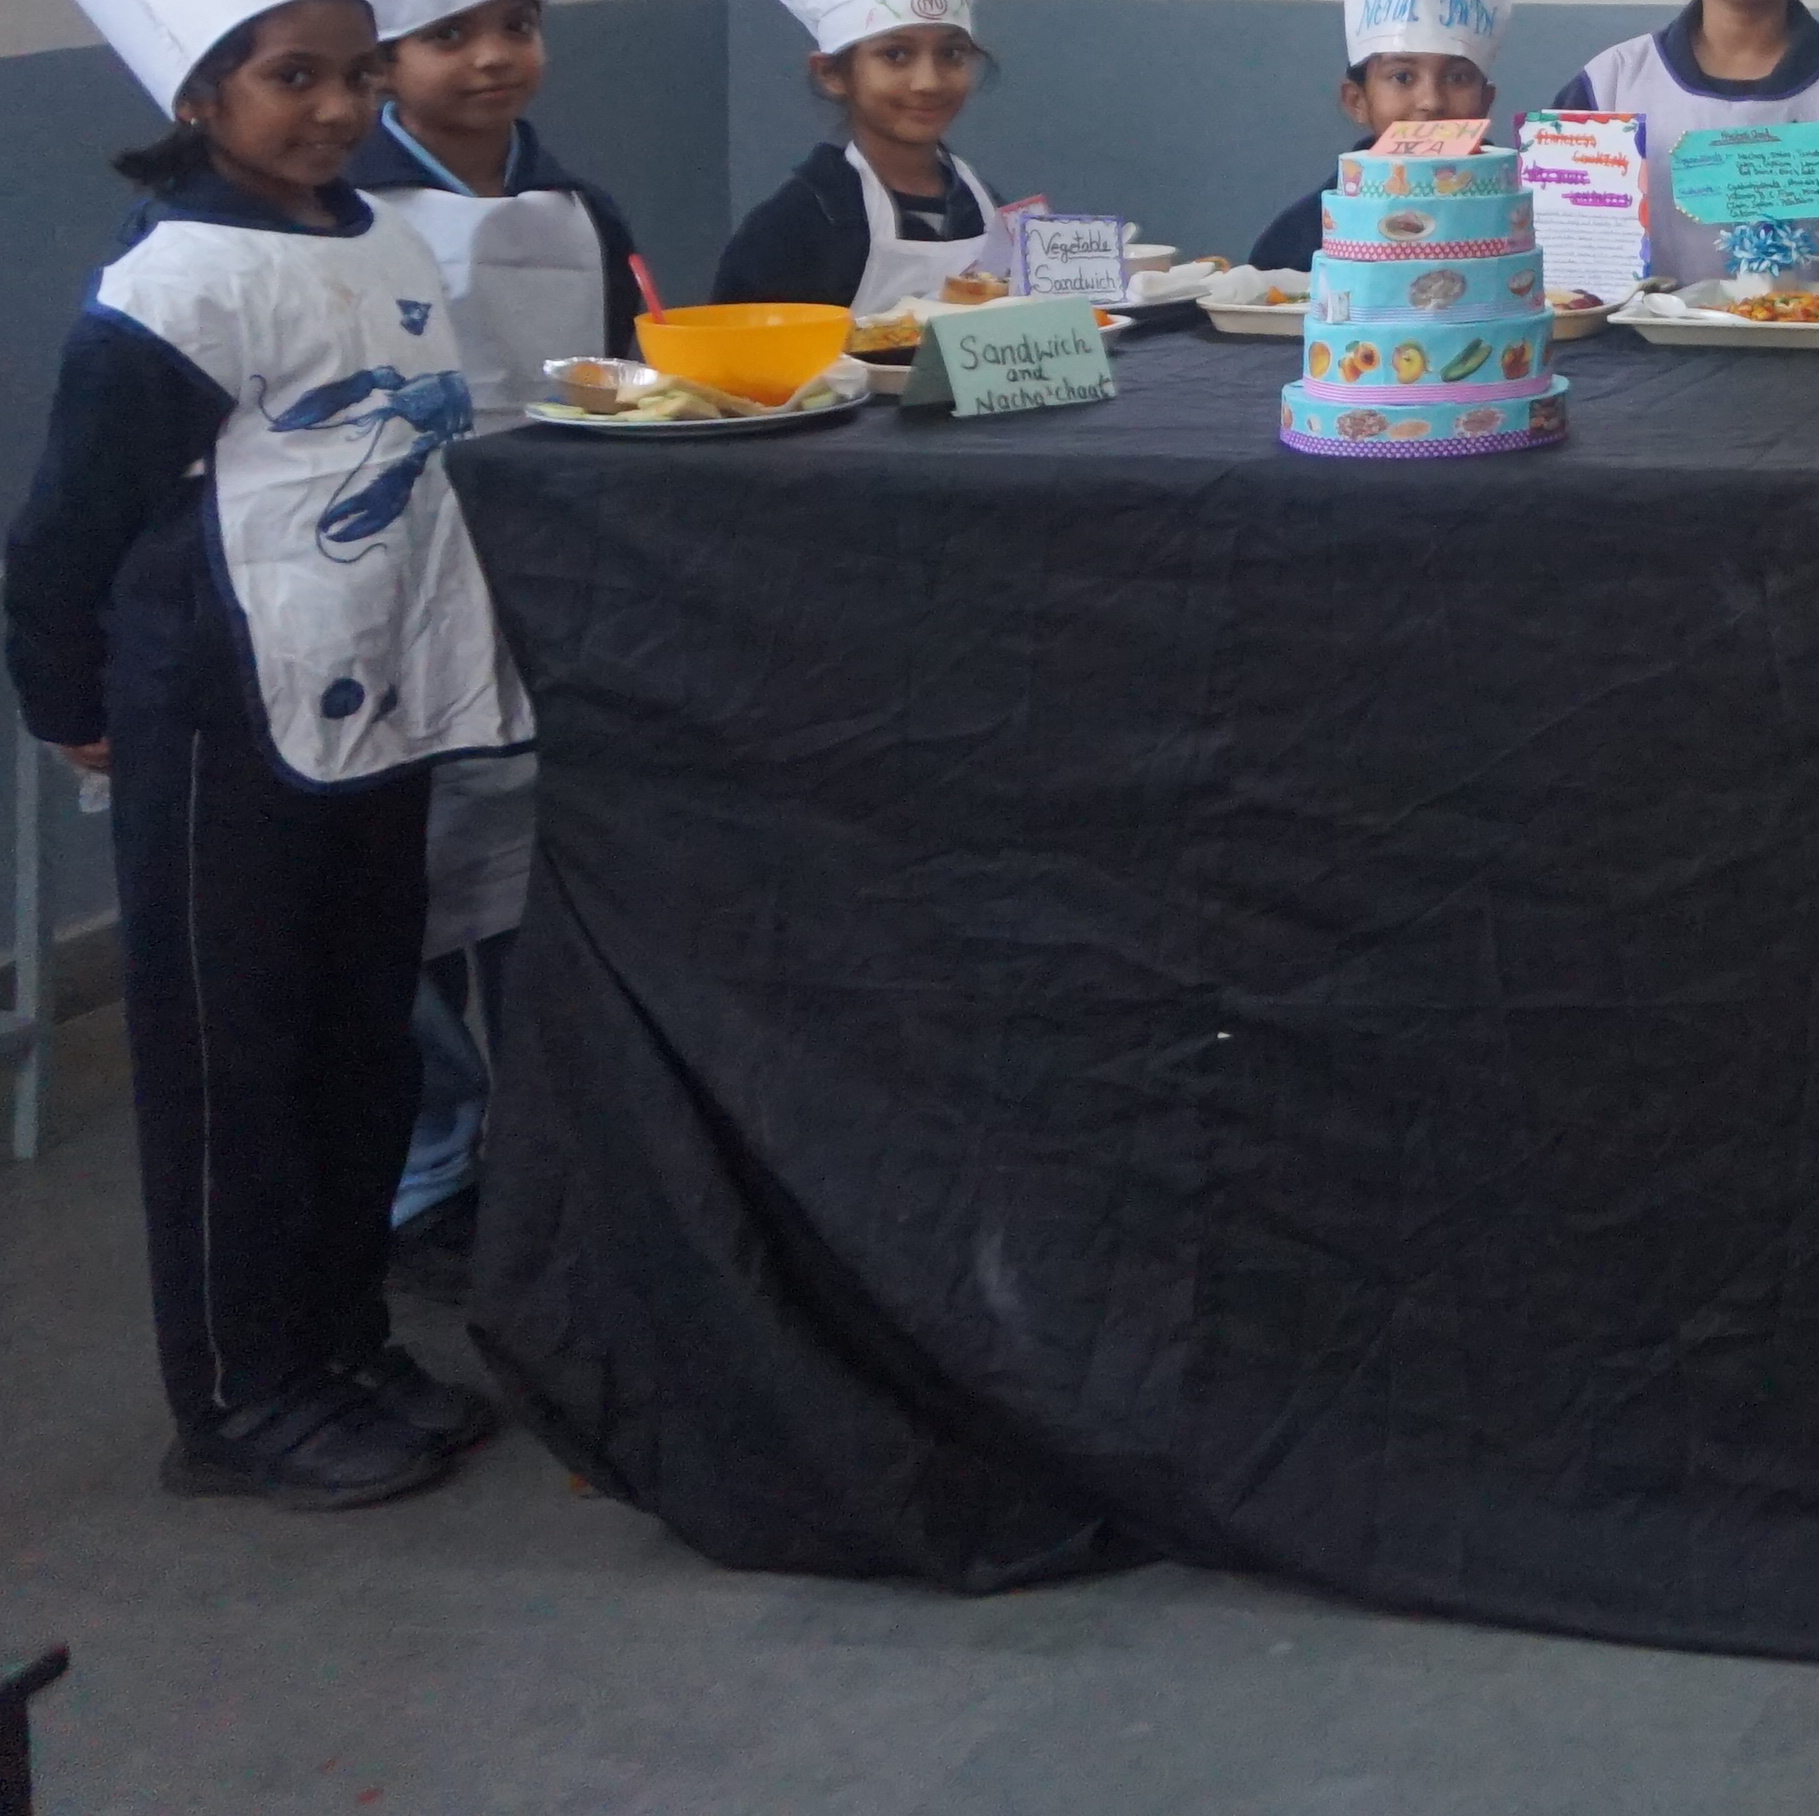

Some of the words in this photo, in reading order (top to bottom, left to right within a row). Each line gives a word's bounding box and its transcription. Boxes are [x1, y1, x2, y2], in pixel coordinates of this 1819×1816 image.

[1030, 229, 1112, 263] Vegetable
[1033, 264, 1117, 293] Sandwich
[960, 327, 1092, 370] Sandwich
[1006, 365, 1051, 382] and
